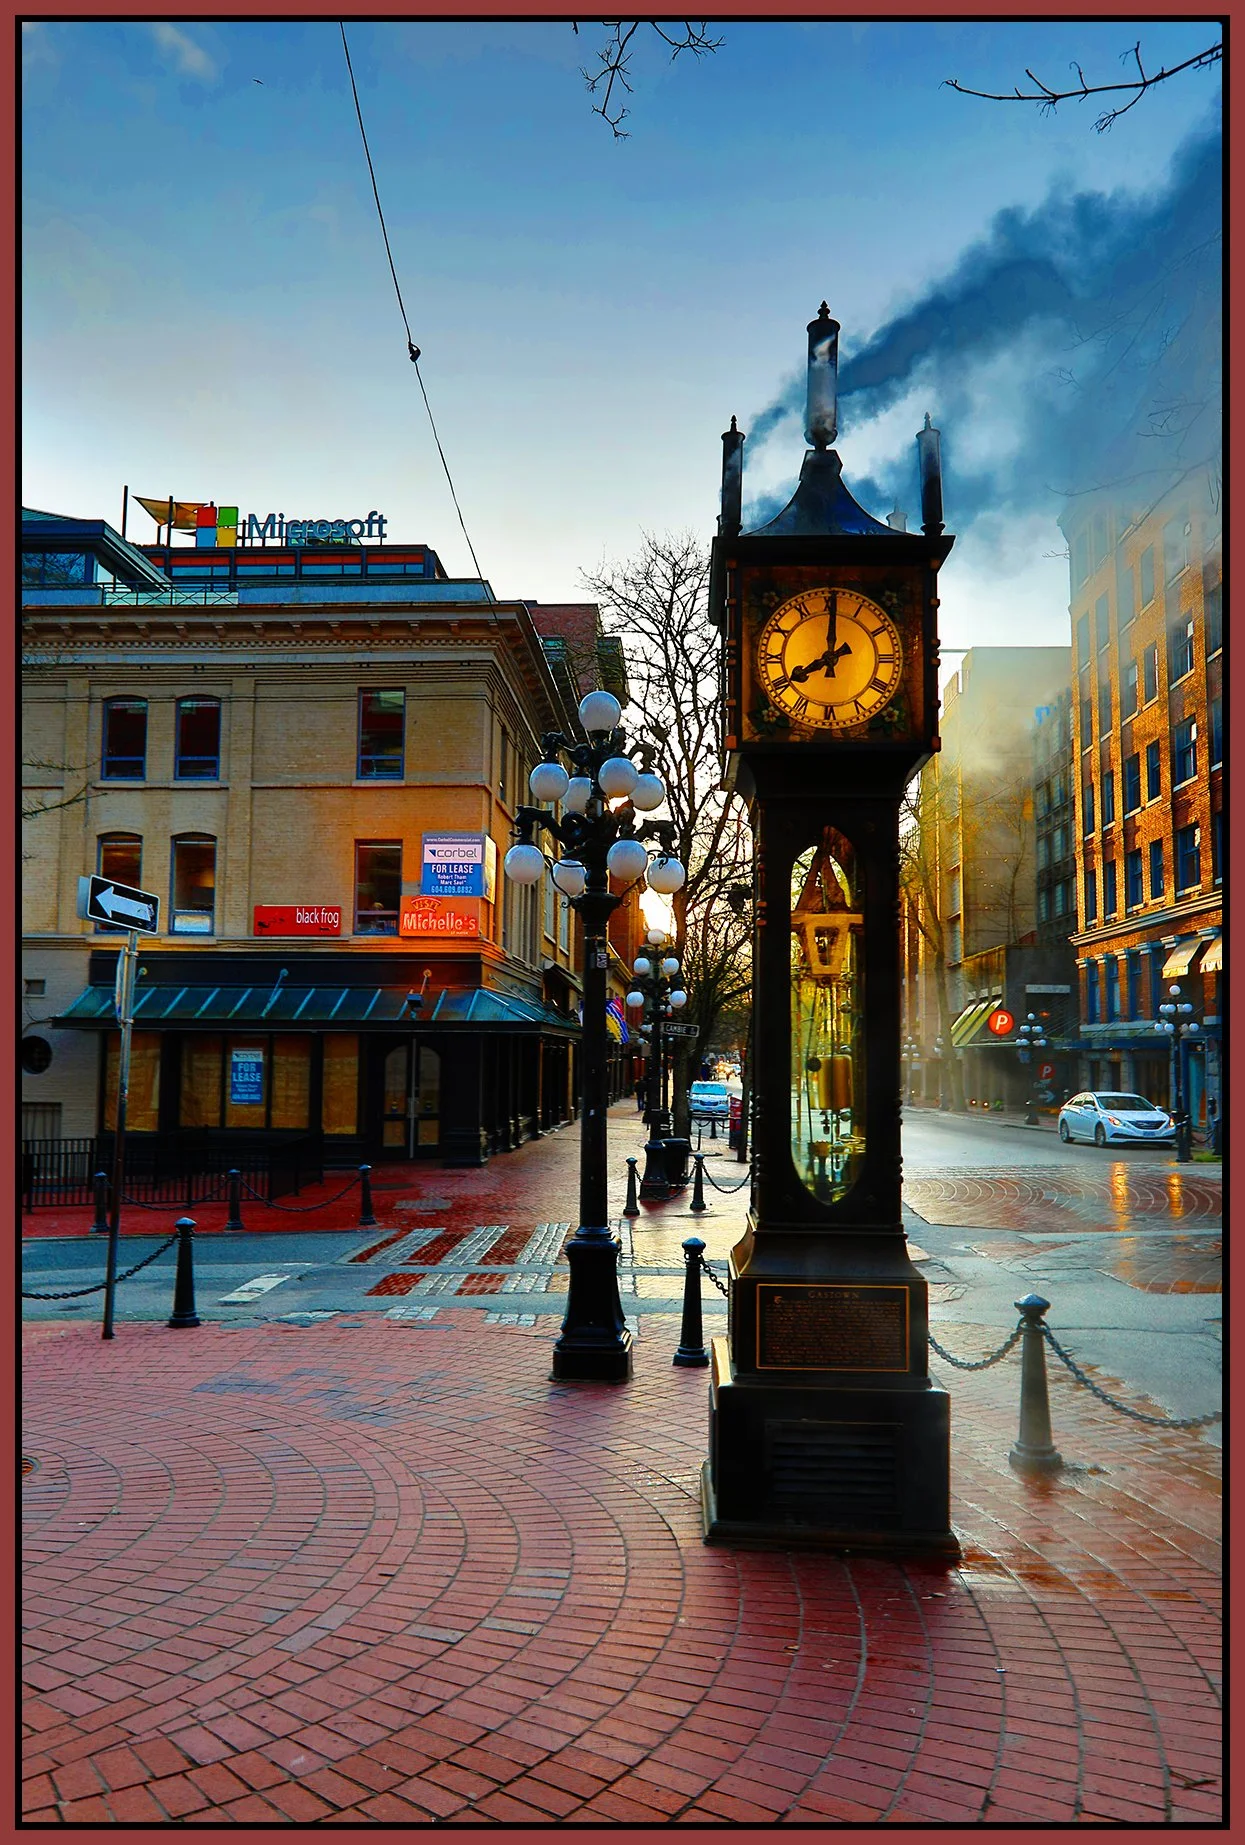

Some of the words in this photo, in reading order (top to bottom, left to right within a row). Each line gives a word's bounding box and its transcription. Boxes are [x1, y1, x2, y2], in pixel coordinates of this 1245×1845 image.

[248, 511, 388, 539] Microsoft
[878, 653, 894, 664] III
[436, 847, 477, 858] corbel
[431, 864, 447, 873] FOR
[449, 864, 474, 873] LEASE
[412, 899, 440, 910] VISIT
[296, 907, 319, 924] black
[320, 907, 339, 928] frog
[402, 912, 476, 931] Michelle's
[996, 1014, 1008, 1030] P
[665, 1024, 687, 1034] CAMBIE
[237, 1063, 257, 1072] FOR
[1042, 1065, 1052, 1078] P
[232, 1072, 262, 1082] LEASE
